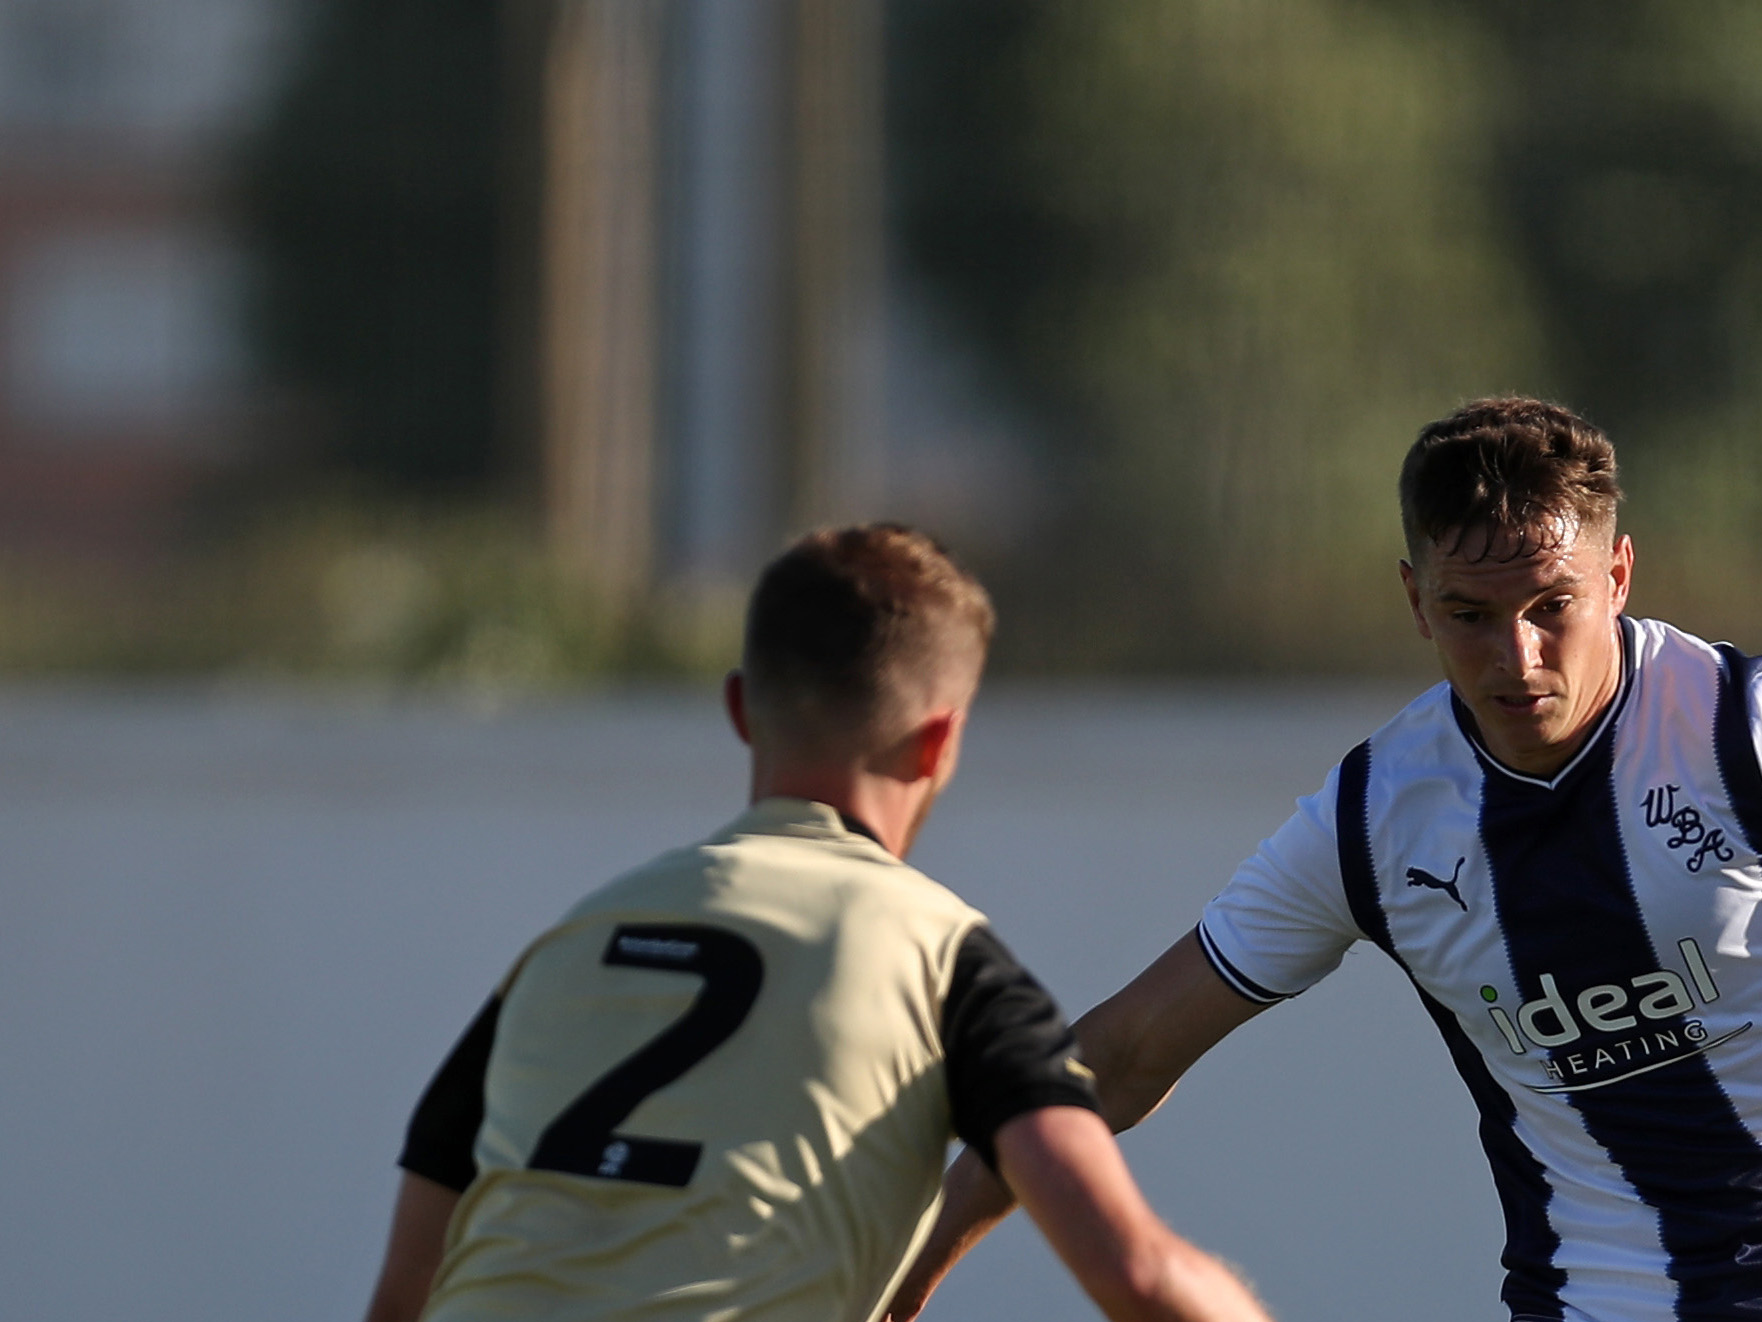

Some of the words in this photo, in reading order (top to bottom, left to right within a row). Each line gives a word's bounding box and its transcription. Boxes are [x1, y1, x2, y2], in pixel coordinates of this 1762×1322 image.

[1640, 784, 1734, 873] WBA
[1478, 937, 1722, 1056] ideal
[527, 922, 765, 1188] 2
[1538, 1018, 1710, 1082] HEATING
